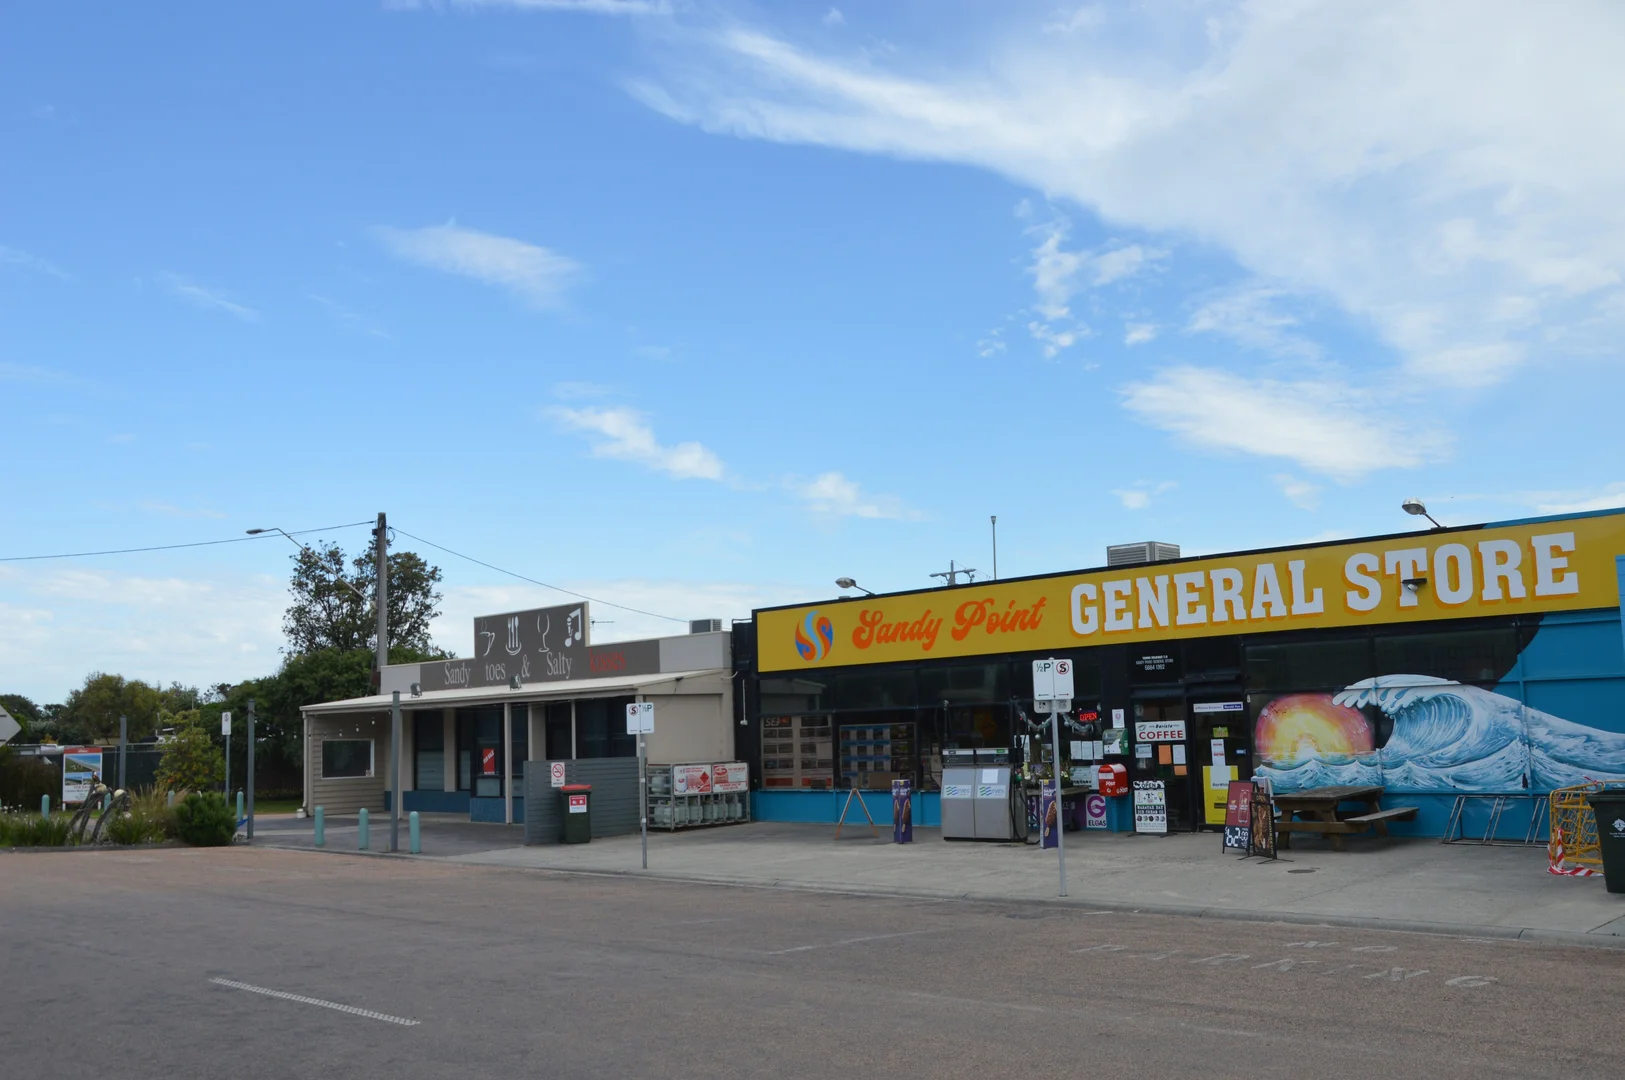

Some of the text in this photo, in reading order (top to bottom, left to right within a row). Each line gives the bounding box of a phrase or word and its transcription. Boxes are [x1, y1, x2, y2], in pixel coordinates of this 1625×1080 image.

[852, 532, 1580, 651] Sandy Point GENERAL STORE
[444, 647, 627, 688] Sandy toes & Salty kisses
[1080, 712, 1098, 722] OPEN
[1139, 730, 1184, 739] COFFEE
[1088, 819, 1107, 827] ELGAS
